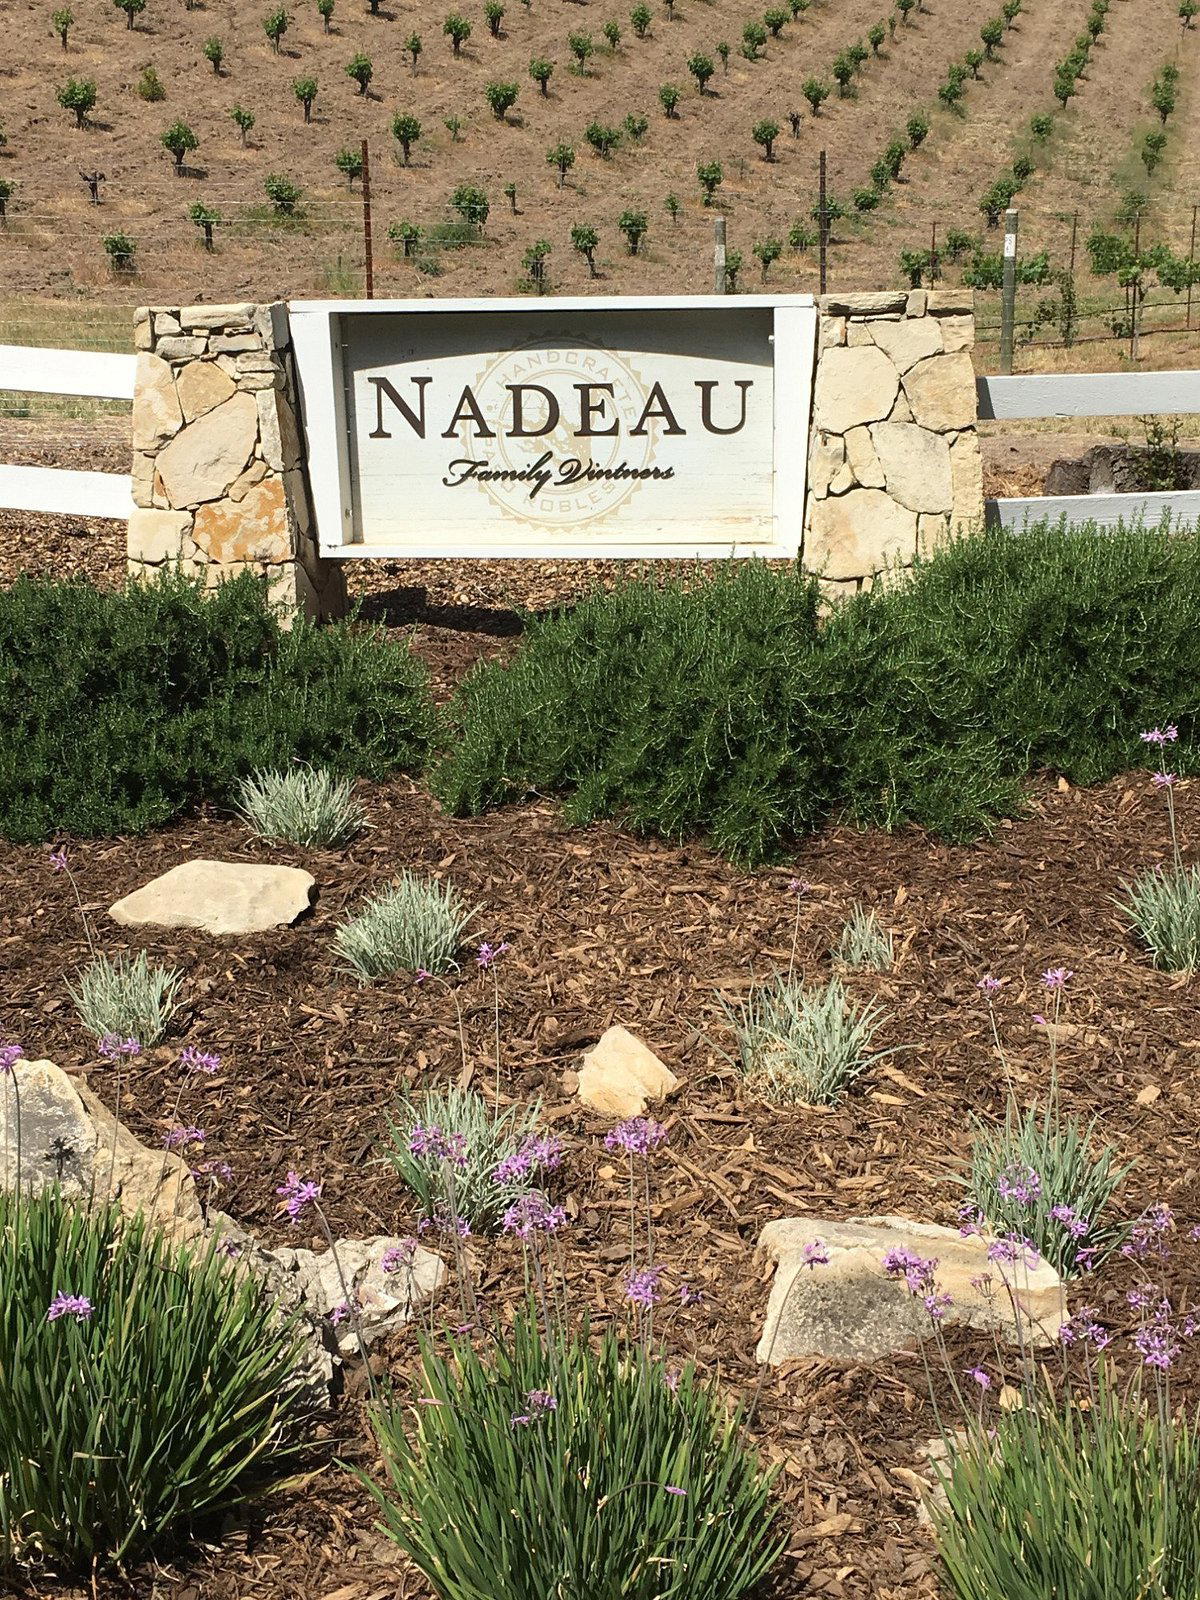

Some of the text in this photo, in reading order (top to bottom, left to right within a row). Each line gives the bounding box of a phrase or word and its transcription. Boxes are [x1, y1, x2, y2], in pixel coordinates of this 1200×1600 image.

[368, 376, 754, 439] NADEAU
[442, 450, 675, 499] Family Vintners
